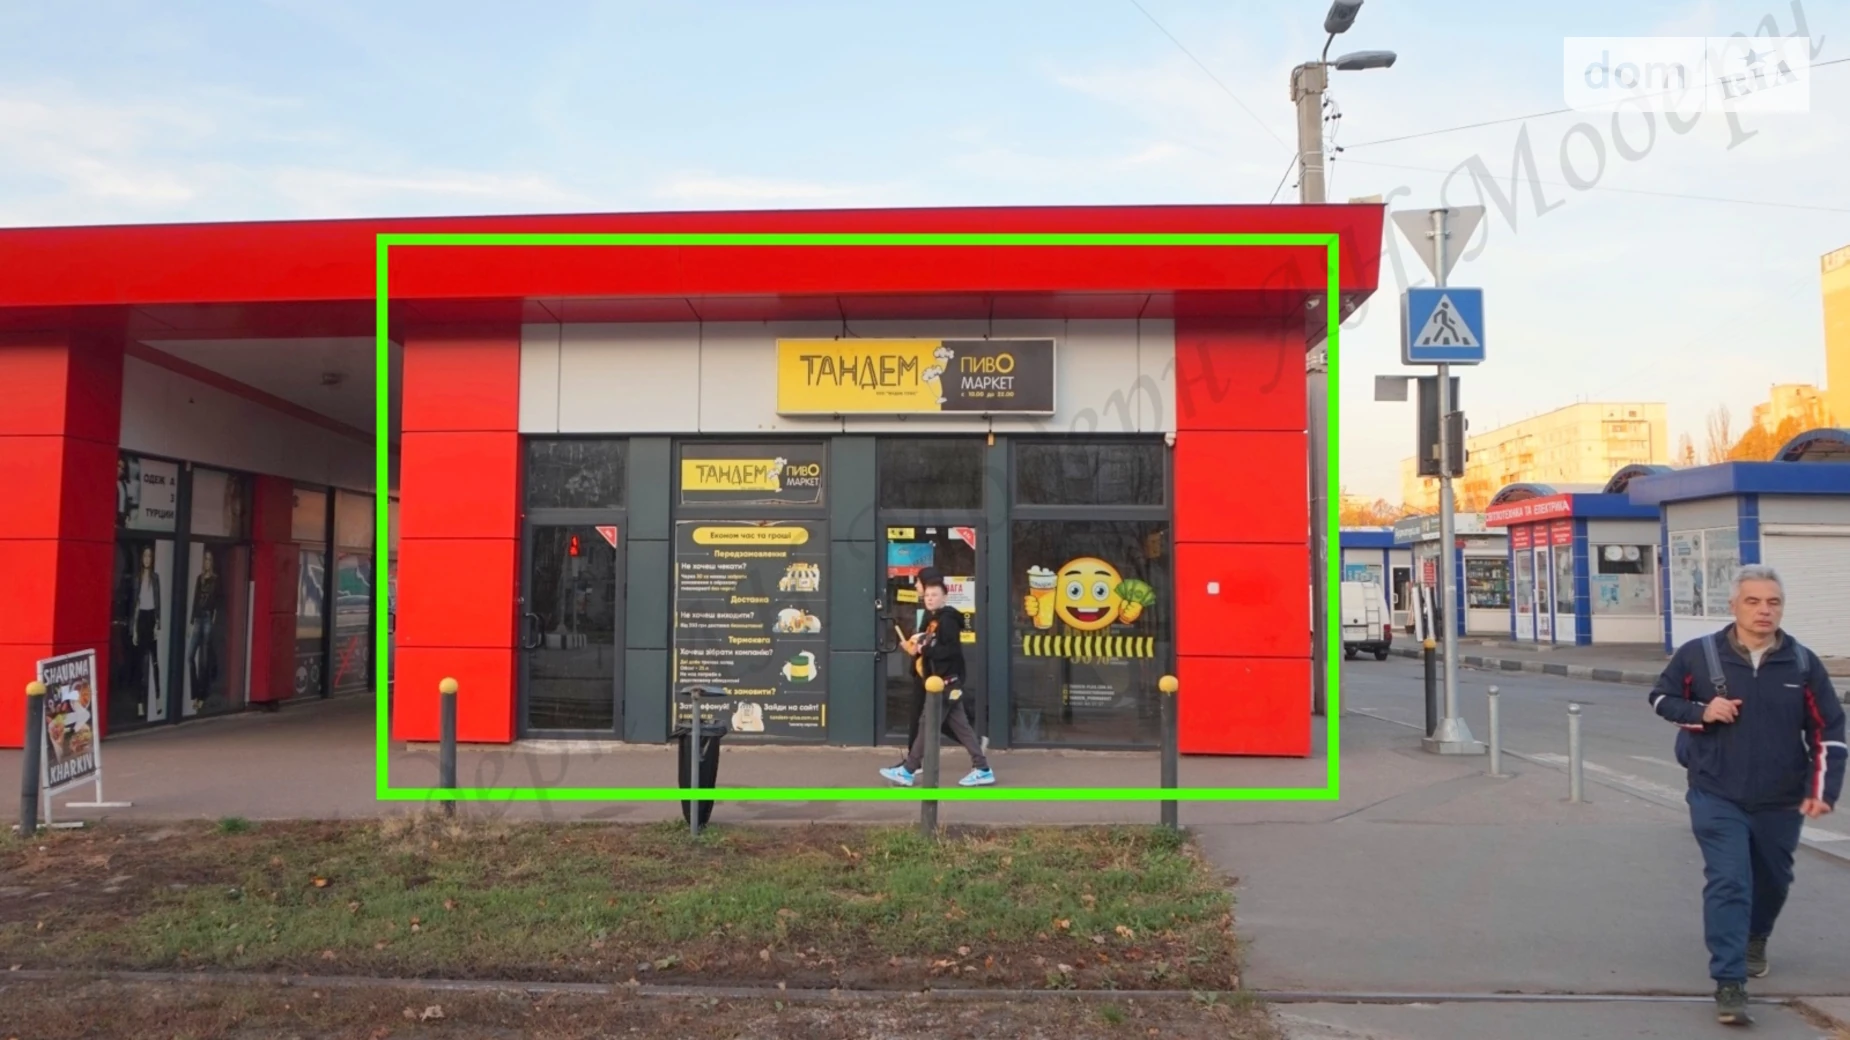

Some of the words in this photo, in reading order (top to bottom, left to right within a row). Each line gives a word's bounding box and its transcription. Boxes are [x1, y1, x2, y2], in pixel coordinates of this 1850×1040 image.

[961, 353, 1014, 374] ПИВО
[800, 354, 918, 390] ТАНДЕМ
[961, 376, 1014, 390] МАРКЕТ
[696, 464, 768, 486] ТАНДЕМ
[786, 463, 820, 477] ПИВО
[786, 477, 820, 487] МАРКЕТ
[768, 532, 792, 540] гроші
[714, 550, 787, 558] Передзамовлення
[717, 562, 747, 571] чекати?
[730, 596, 770, 604] Доставка
[728, 636, 770, 644] Термокега
[680, 648, 704, 656] Хочеш
[706, 648, 734, 657] зібрати
[44, 660, 88, 686] SHAURMA
[734, 687, 776, 696] замовити?
[680, 702, 730, 712] Затефонуй!
[764, 702, 786, 712] Зайди
[800, 702, 820, 711] сайт!
[50, 754, 92, 785] KHARKIV
